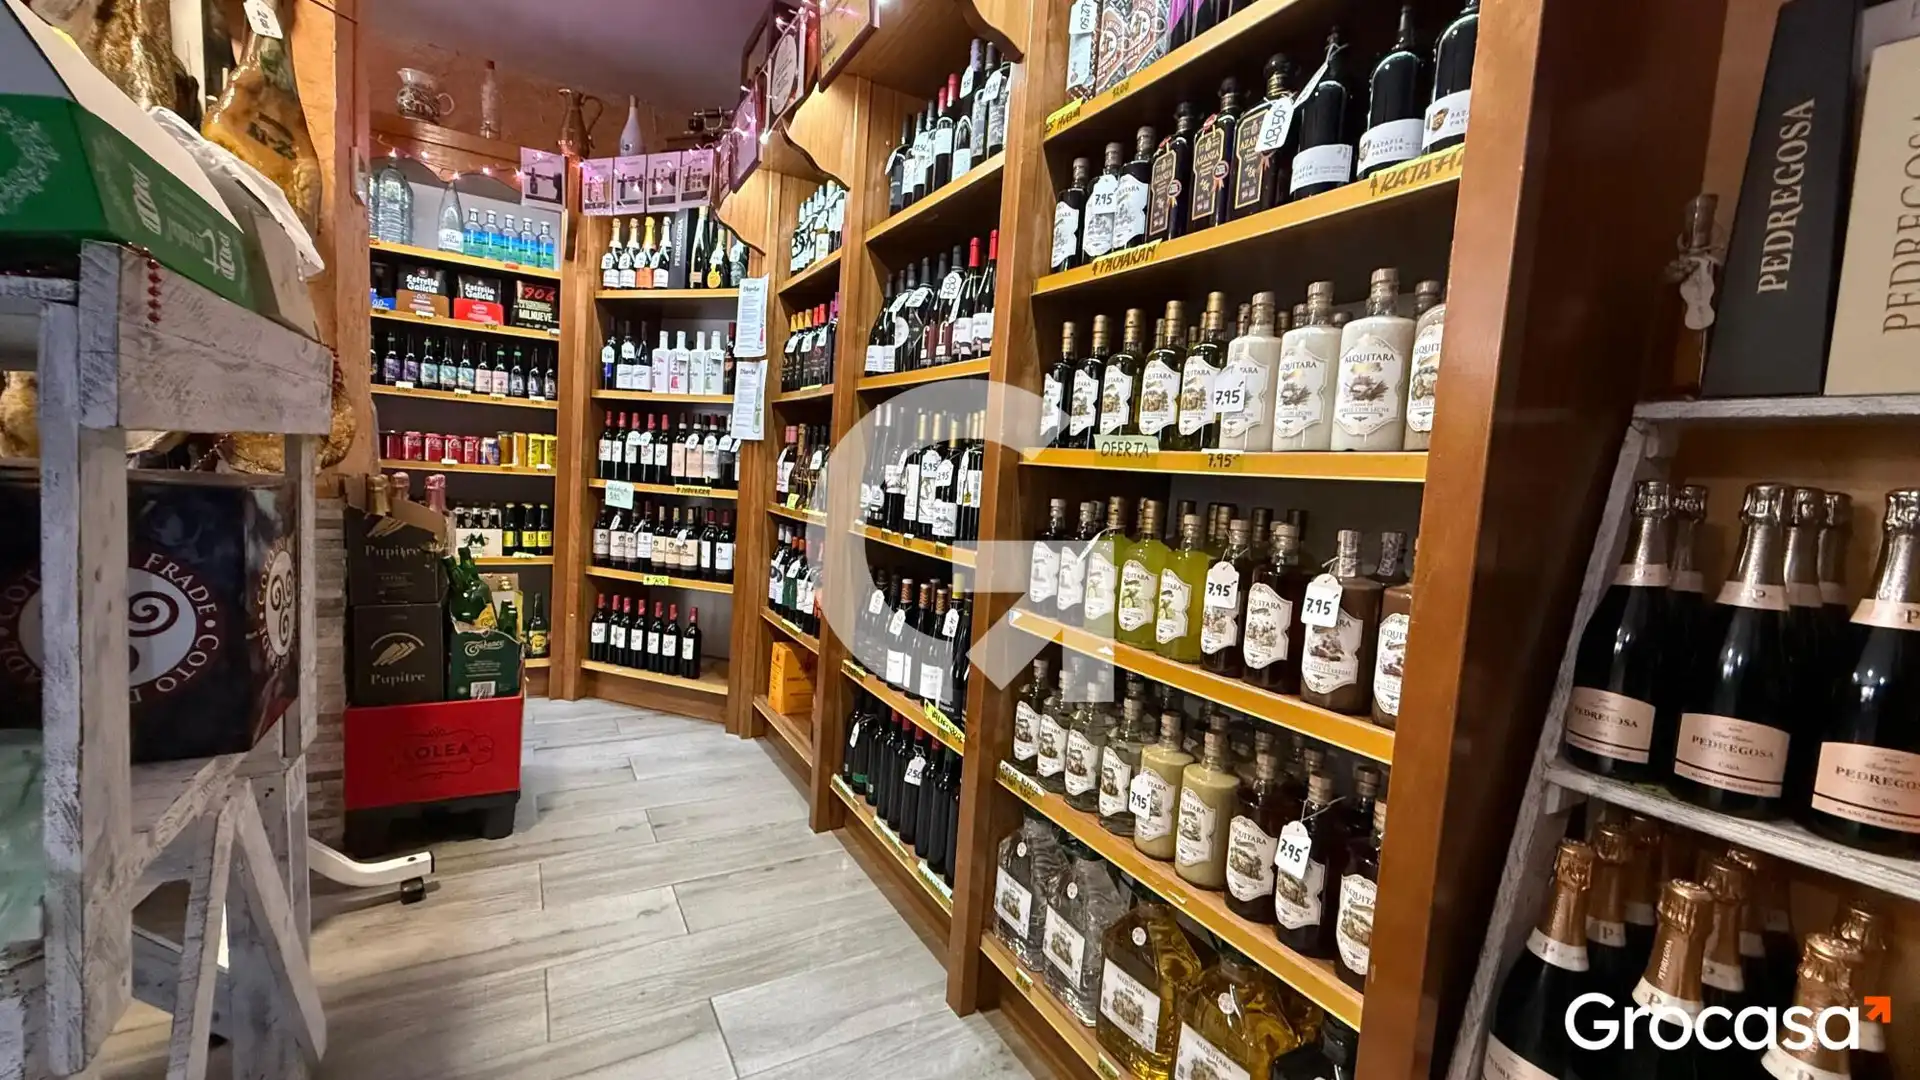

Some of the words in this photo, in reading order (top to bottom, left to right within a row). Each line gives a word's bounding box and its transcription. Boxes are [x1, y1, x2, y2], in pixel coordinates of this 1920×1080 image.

[1757, 98, 1815, 295] PEDREGOSA
[674, 218, 683, 267] PEDREGOSA
[406, 274, 439, 287] Estrella
[407, 282, 437, 293] Galicia
[465, 283, 495, 294] Estrella
[466, 290, 494, 301] Galicia
[524, 286, 556, 302] 906
[1344, 352, 1395, 364] ALQUITARA
[1215, 390, 1240, 405] 7,95
[1101, 441, 1150, 458] OFERTA
[923, 462, 938, 472] 5,95
[1207, 453, 1232, 467] 7,95
[364, 545, 421, 559] Pupitre
[143, 552, 218, 614] FRADE
[1208, 582, 1231, 597] 7,95
[1306, 597, 1332, 615] 7,95
[156, 634, 219, 692] COTO
[371, 672, 425, 686] Pupitre
[1574, 706, 1638, 728] PEDREGOSA
[1692, 736, 1774, 759] PEDREGOSA
[1131, 792, 1148, 810] 7,95
[1279, 838, 1304, 864] 7,95
